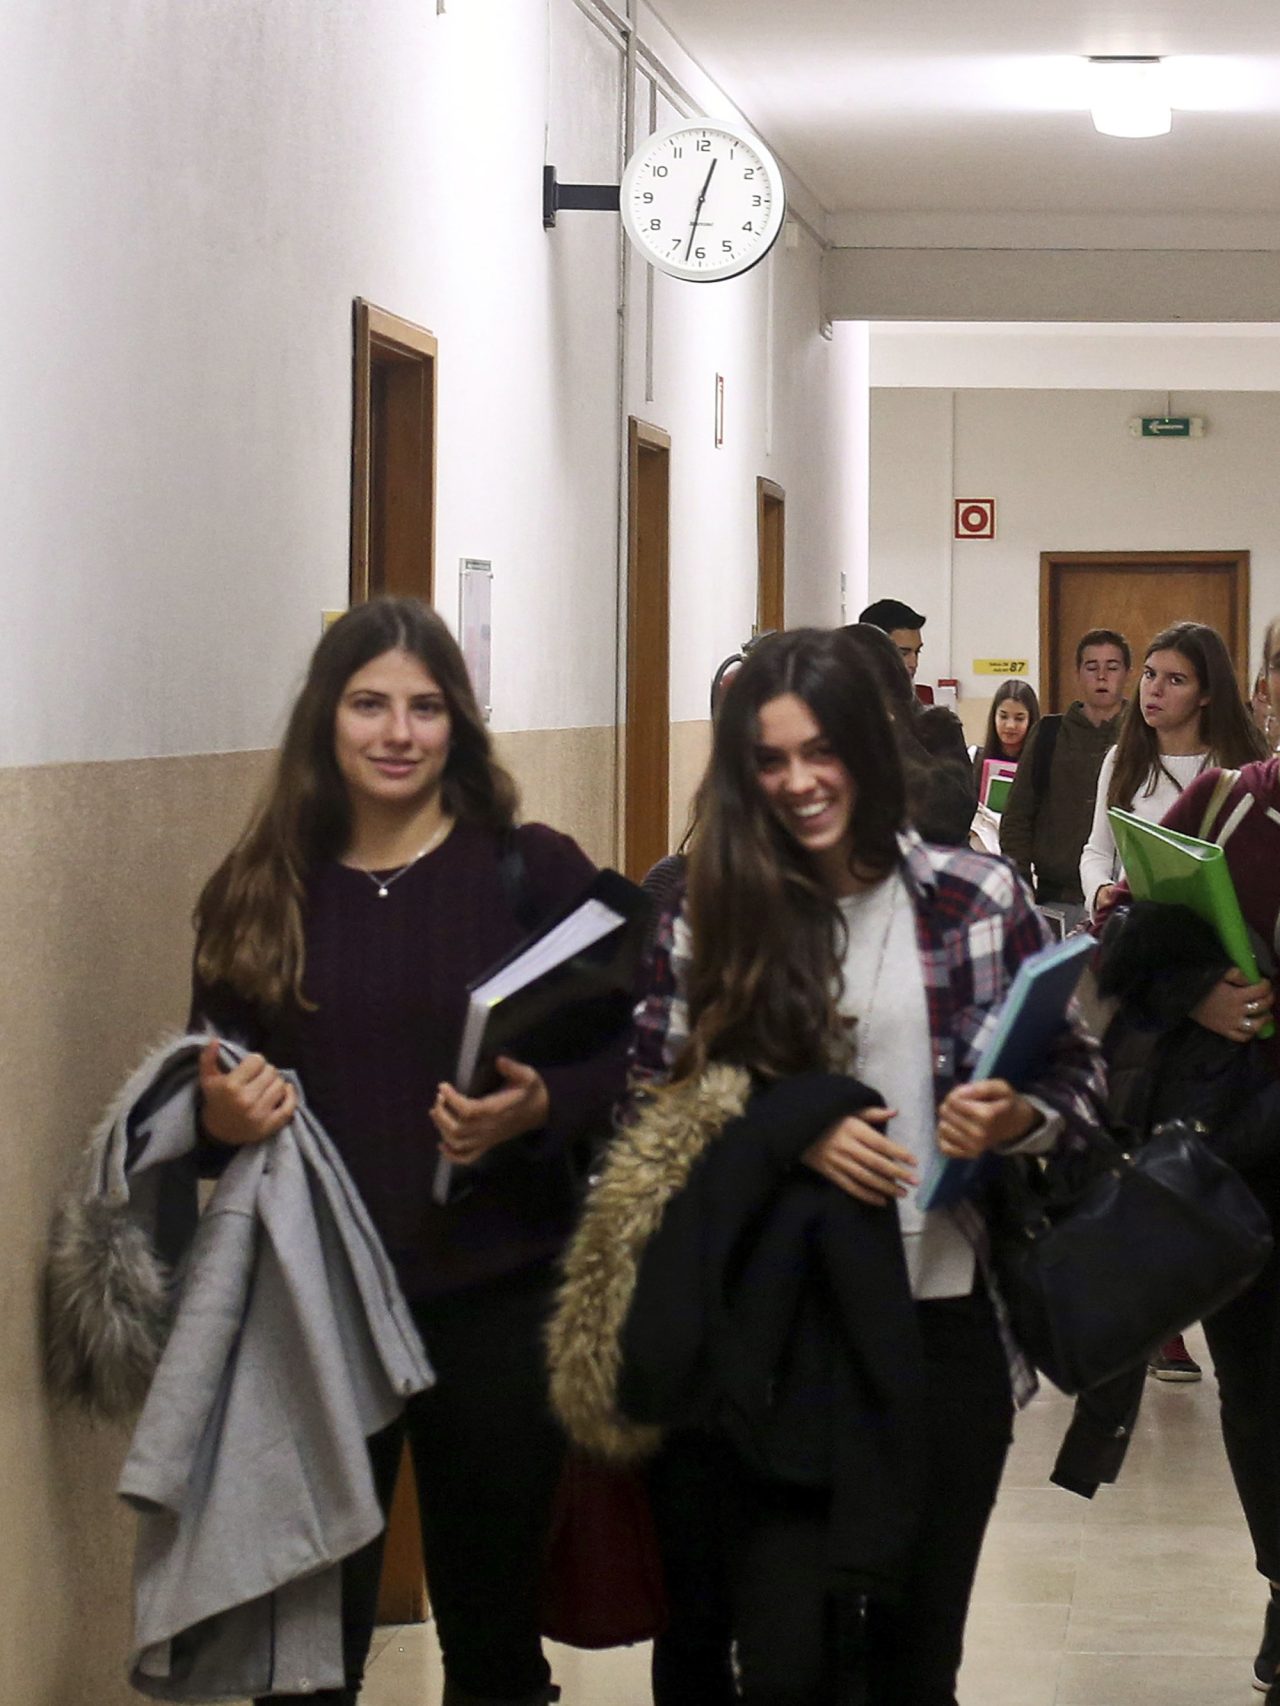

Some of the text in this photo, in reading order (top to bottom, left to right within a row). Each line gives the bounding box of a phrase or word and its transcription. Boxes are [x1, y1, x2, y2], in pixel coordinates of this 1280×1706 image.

[696, 139, 711, 152] 12
[673, 147, 683, 159] 11
[730, 148, 734, 160] 1
[652, 165, 668, 178] 10
[743, 168, 754, 180] 2
[643, 192, 653, 204] 9
[752, 195, 761, 207] 3
[650, 218, 661, 231] 8
[742, 221, 752, 232] 4
[672, 239, 682, 250] 7
[722, 240, 732, 252] 5
[695, 247, 706, 259] 6
[1009, 662, 1025, 672] 87
